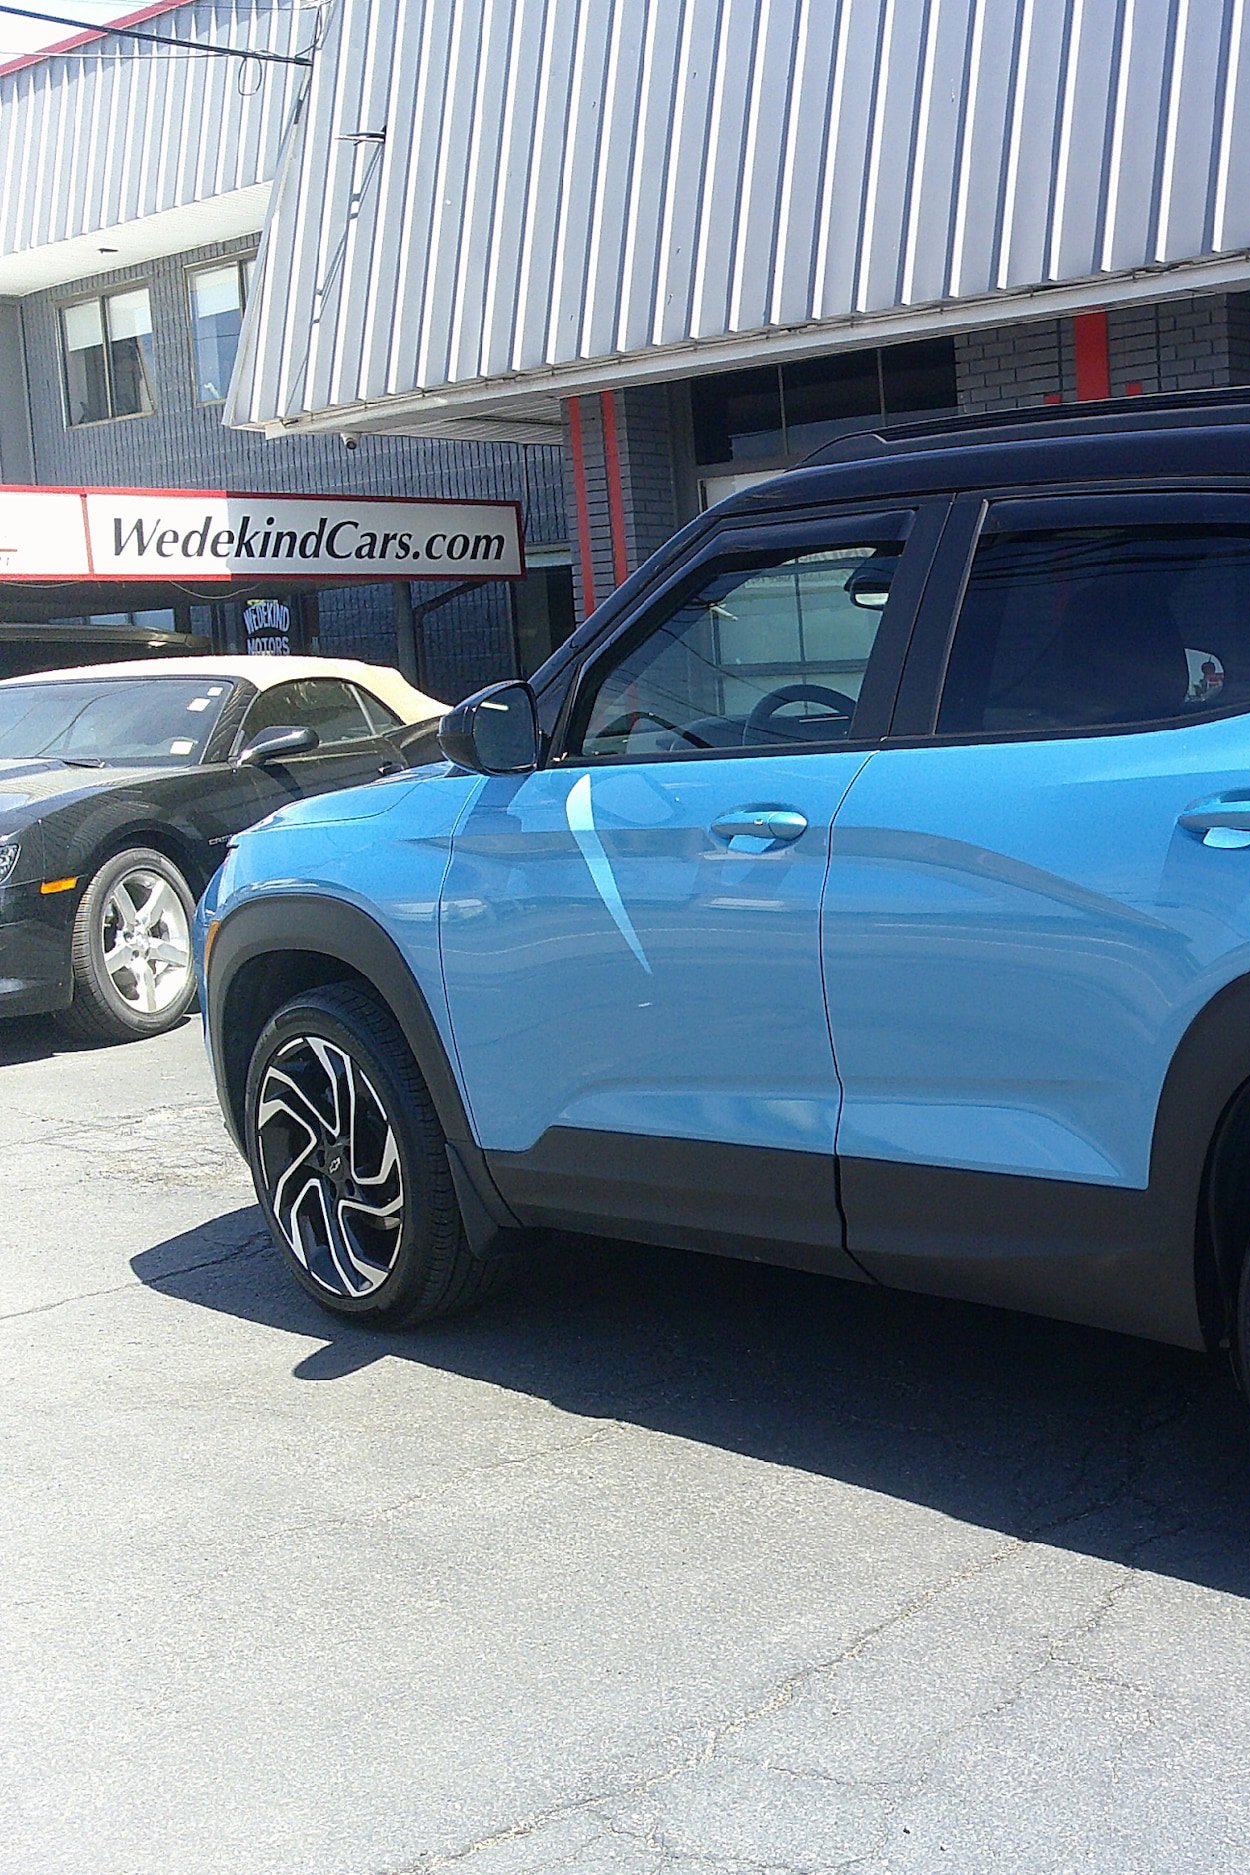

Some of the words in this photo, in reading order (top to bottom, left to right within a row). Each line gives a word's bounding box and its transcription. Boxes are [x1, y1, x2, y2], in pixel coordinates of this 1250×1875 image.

[113, 515, 505, 561] WedekindCars.com
[243, 603, 290, 635] WEDEKIND
[246, 636, 291, 656] MOTORS
